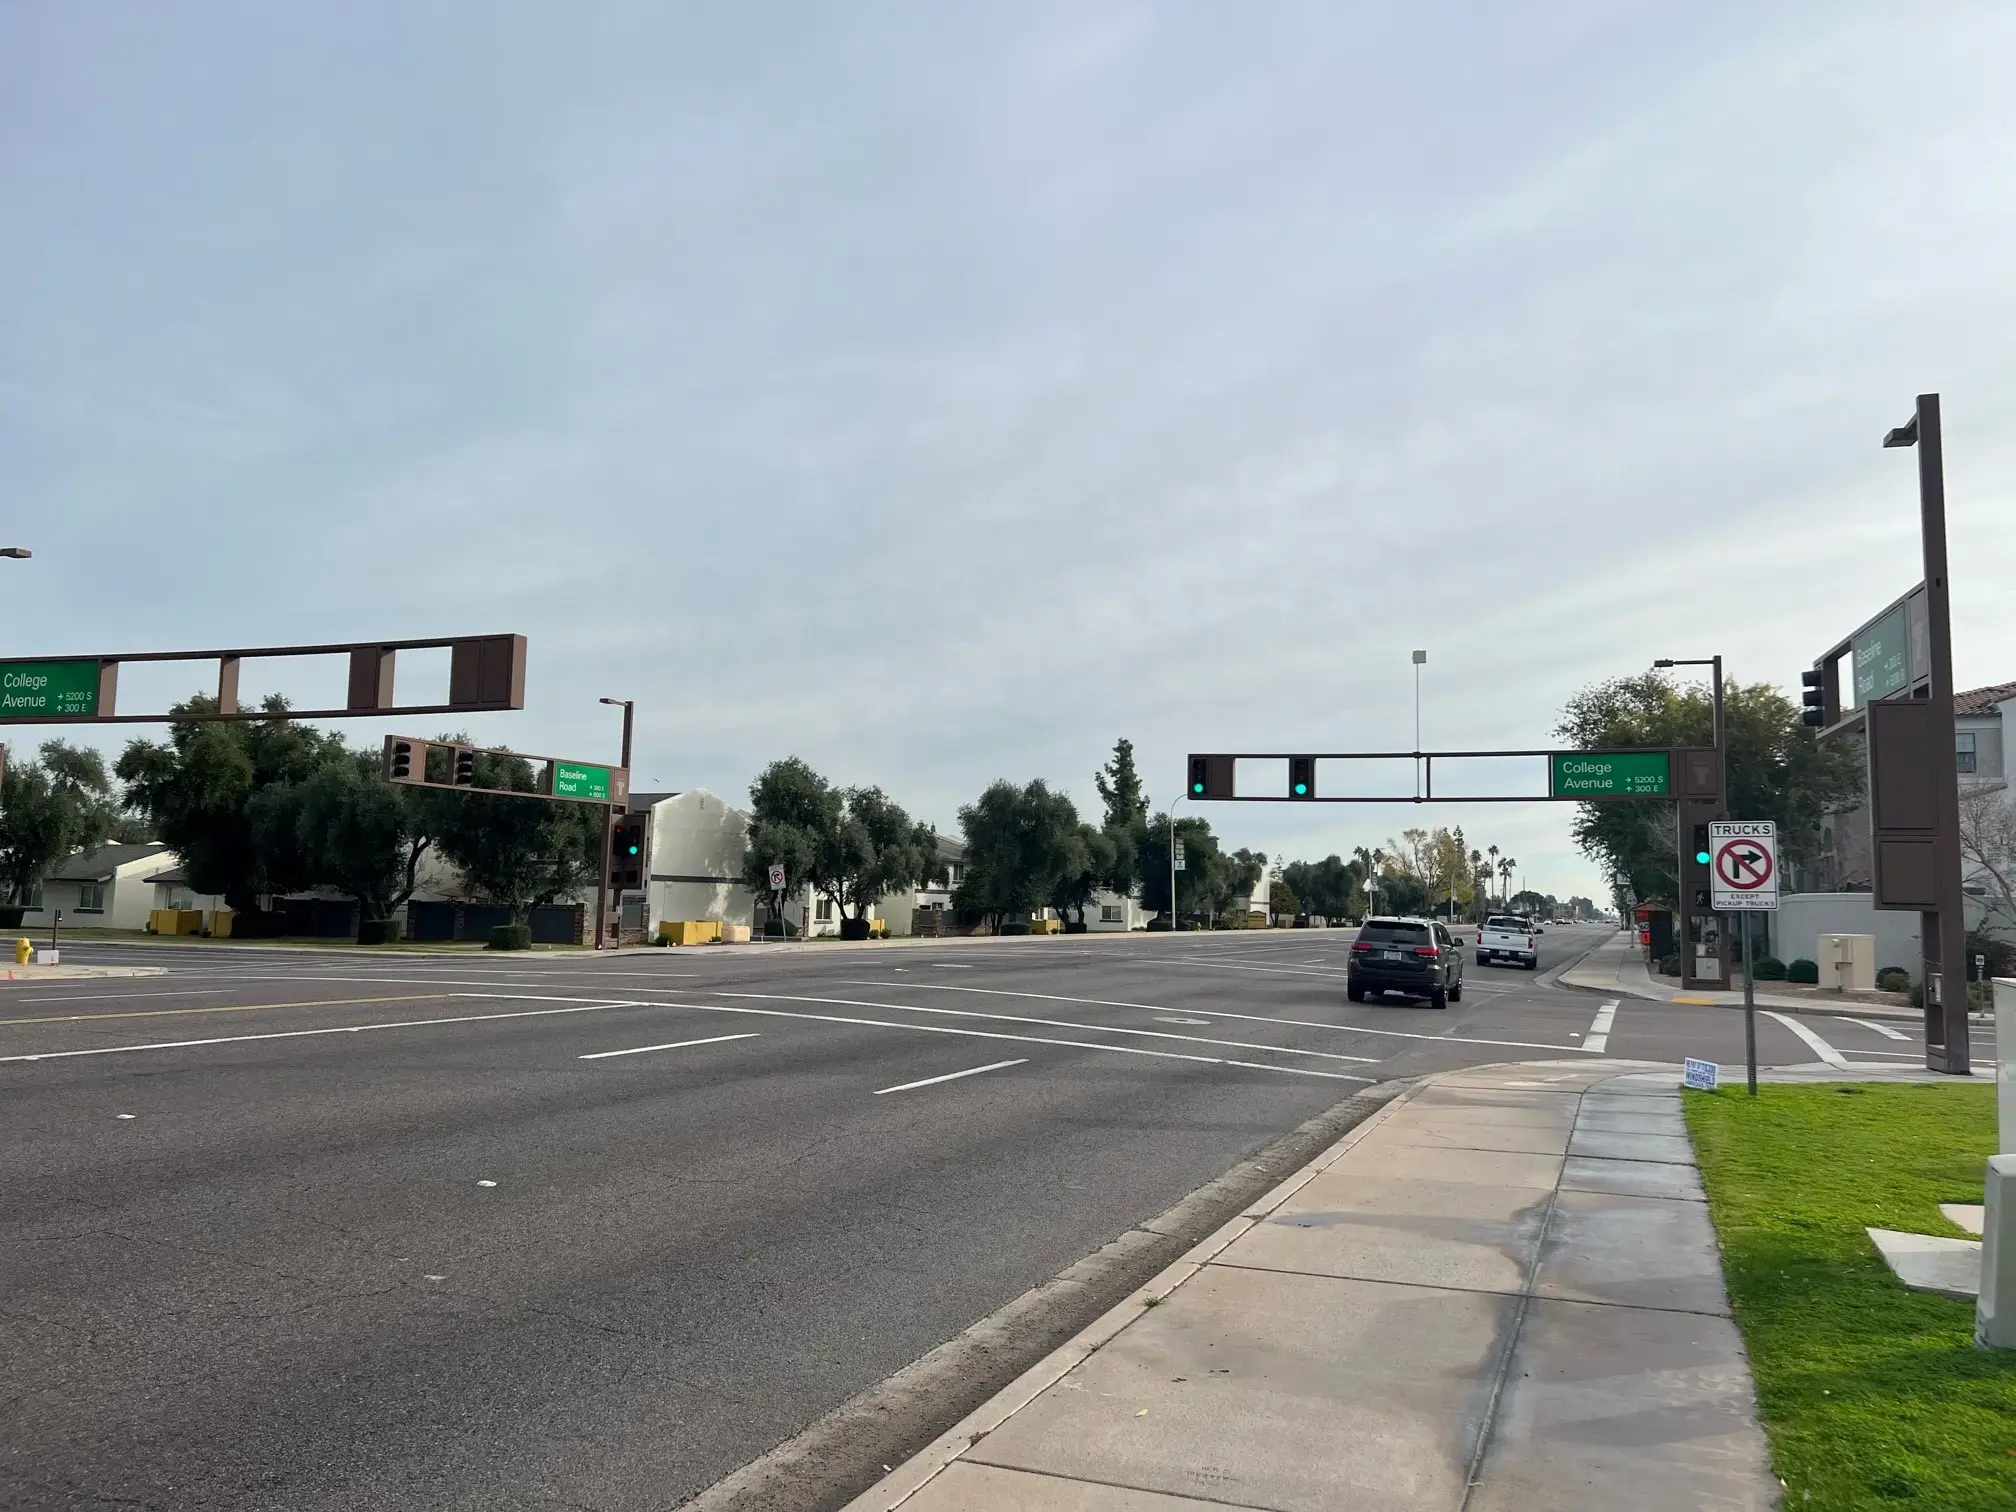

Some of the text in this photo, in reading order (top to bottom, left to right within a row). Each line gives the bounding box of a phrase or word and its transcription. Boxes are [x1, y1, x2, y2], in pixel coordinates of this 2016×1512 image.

[4, 672, 48, 690] College
[2, 693, 46, 708] Avenue
[65, 691, 93, 701] 5200 S
[64, 703, 87, 713] 300 E
[1563, 762, 1612, 775] College
[560, 769, 587, 780] Baseline
[1634, 775, 1664, 784] 5200 S
[559, 781, 577, 792] Road
[1563, 777, 1613, 789] Avenue
[1634, 785, 1652, 793] 300
[1714, 825, 1771, 835] TRUCKS
[1686, 1071, 1715, 1085] WINDSHIELD
